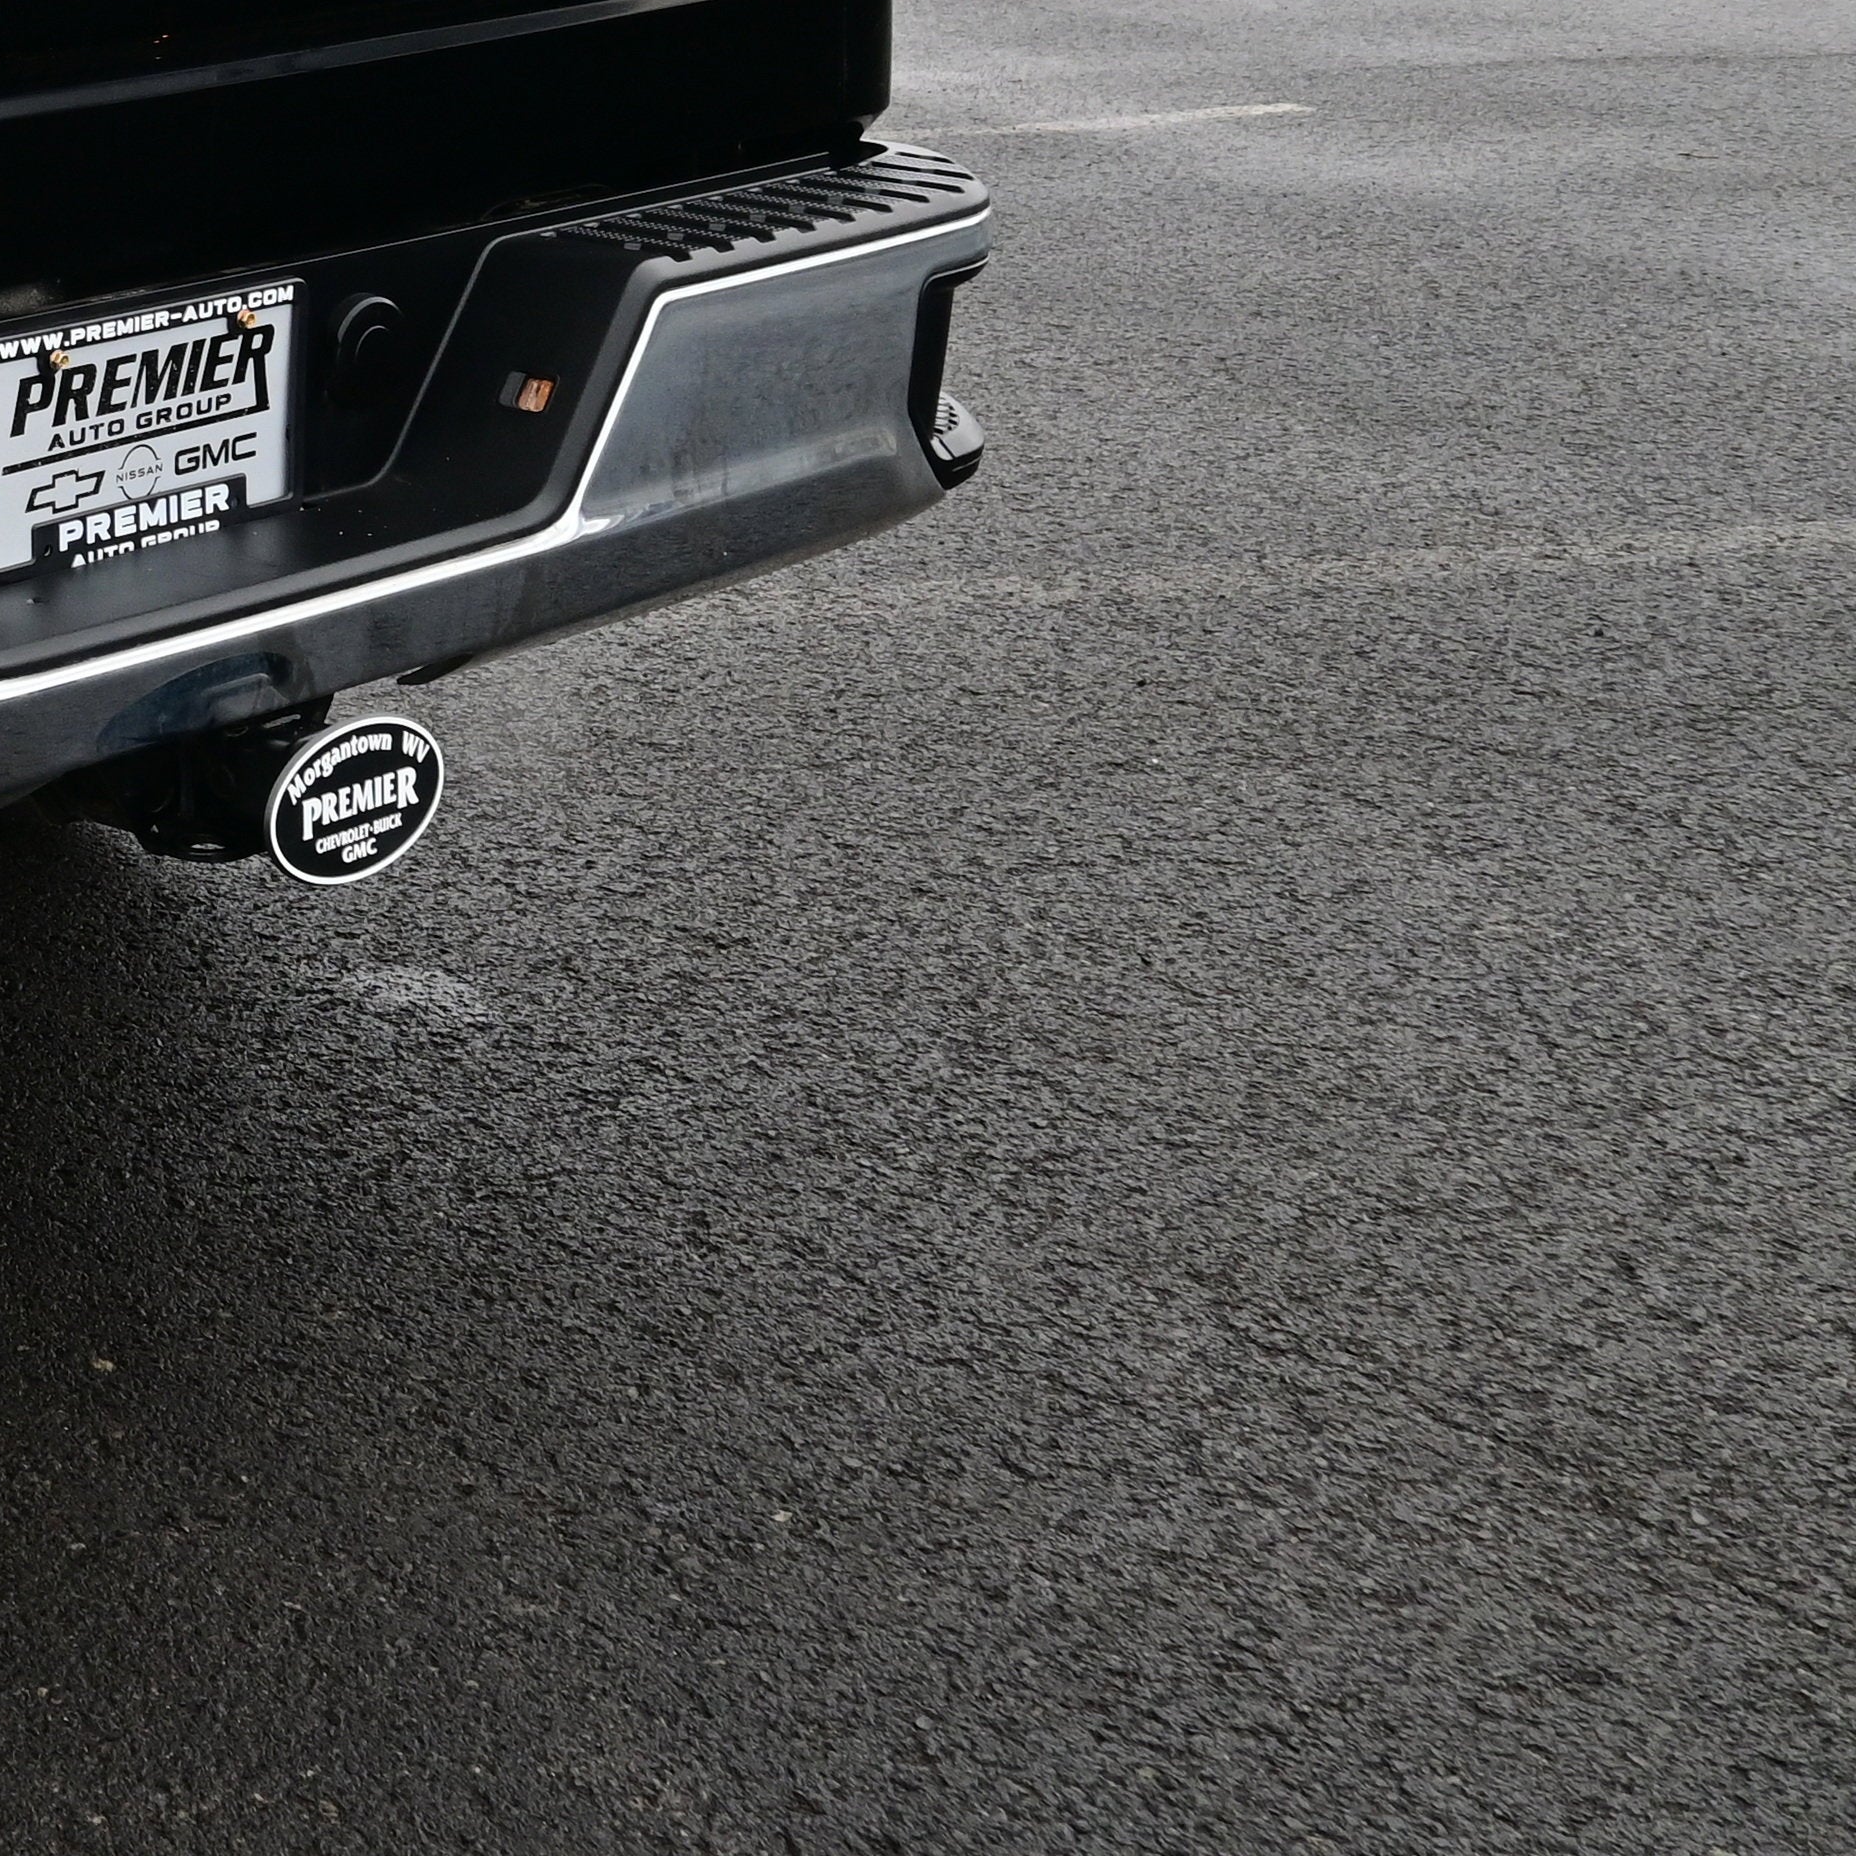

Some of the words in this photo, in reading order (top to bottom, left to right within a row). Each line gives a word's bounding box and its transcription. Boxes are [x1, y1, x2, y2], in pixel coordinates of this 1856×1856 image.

[9, 323, 275, 439] PREMIER
[48, 418, 125, 452] AUTO
[135, 393, 232, 431] GROUP
[174, 432, 258, 476] GMC
[115, 462, 163, 484] NISSAN
[58, 482, 230, 553] PREMIER
[287, 732, 393, 806] Morgantown
[401, 730, 431, 764] WV
[301, 765, 420, 842] PREMIER
[341, 837, 378, 864] GMC
